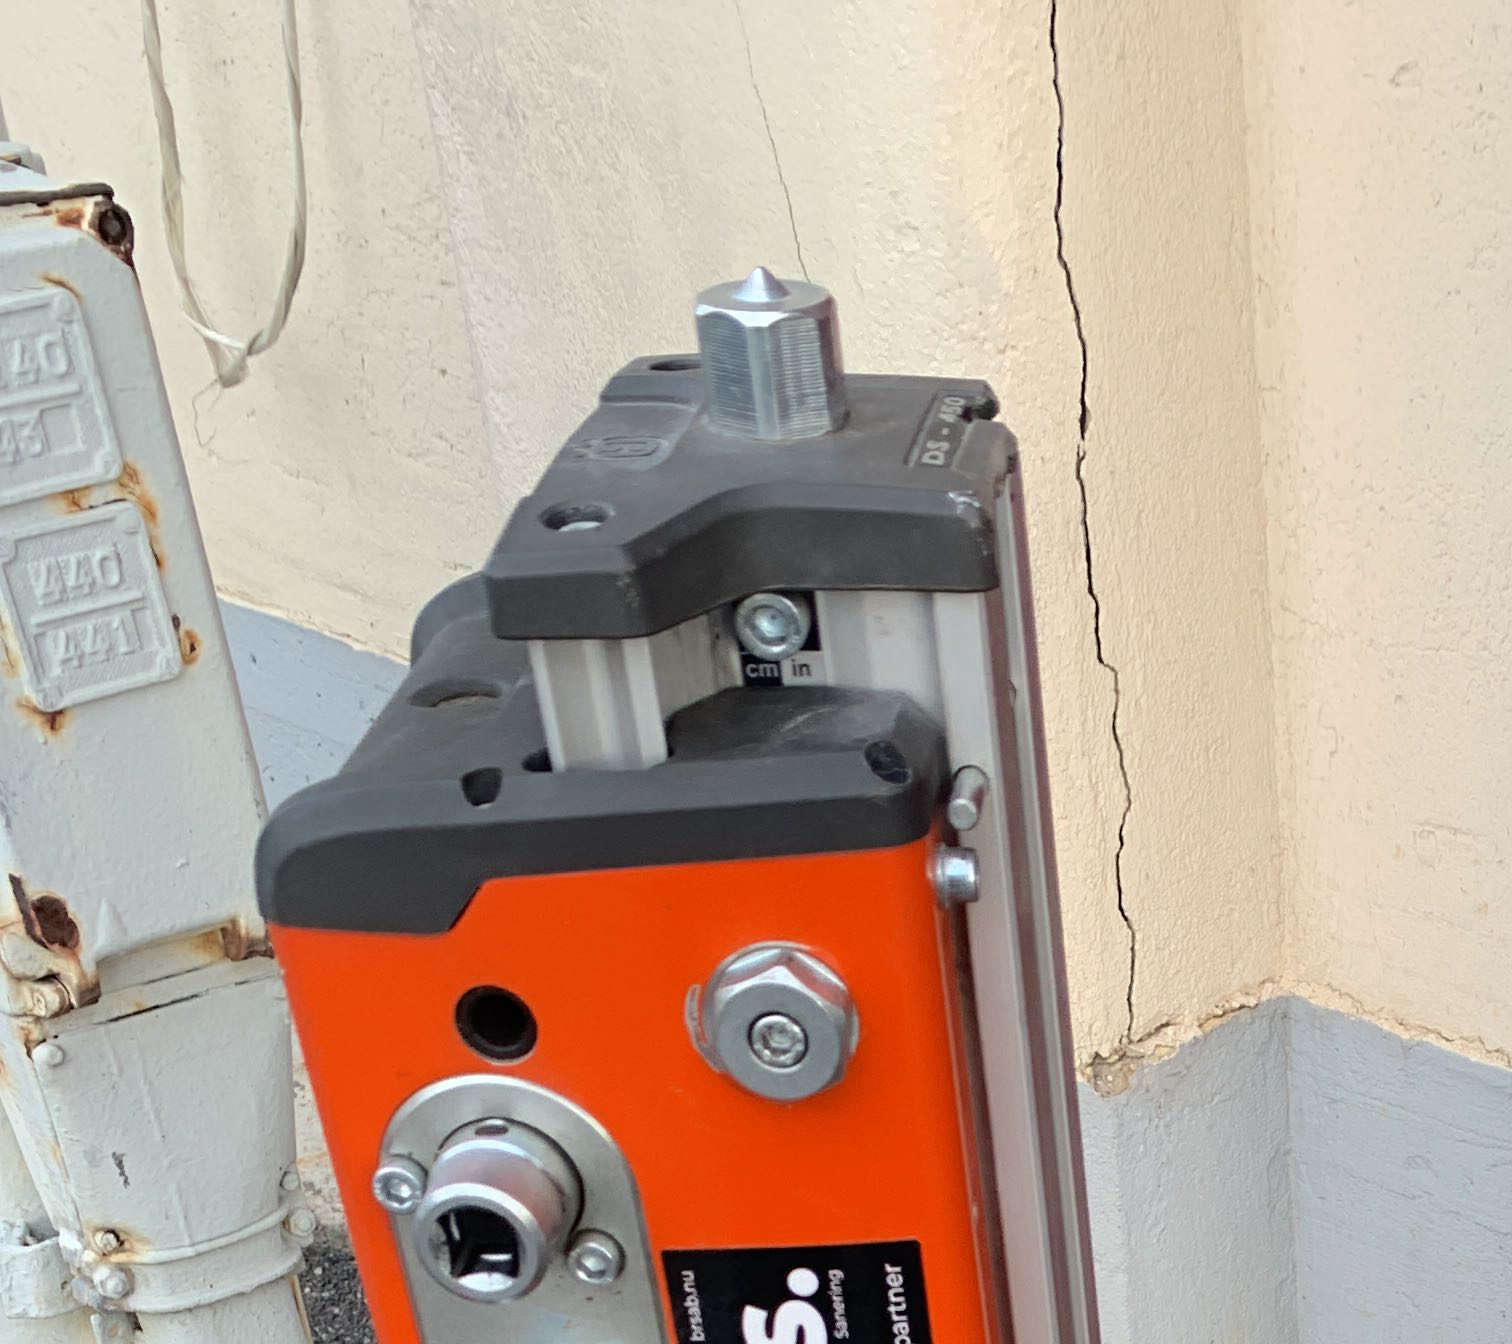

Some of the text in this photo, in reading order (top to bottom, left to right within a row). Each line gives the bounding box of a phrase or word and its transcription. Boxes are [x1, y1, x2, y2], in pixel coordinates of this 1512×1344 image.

[0, 333, 70, 386] 40
[921, 440, 951, 466] DS
[28, 546, 124, 605] 440
[745, 662, 779, 678] cm
[791, 658, 812, 678] in
[681, 1269, 706, 1342] brsab.nu
[828, 1268, 850, 1340] Sanering
